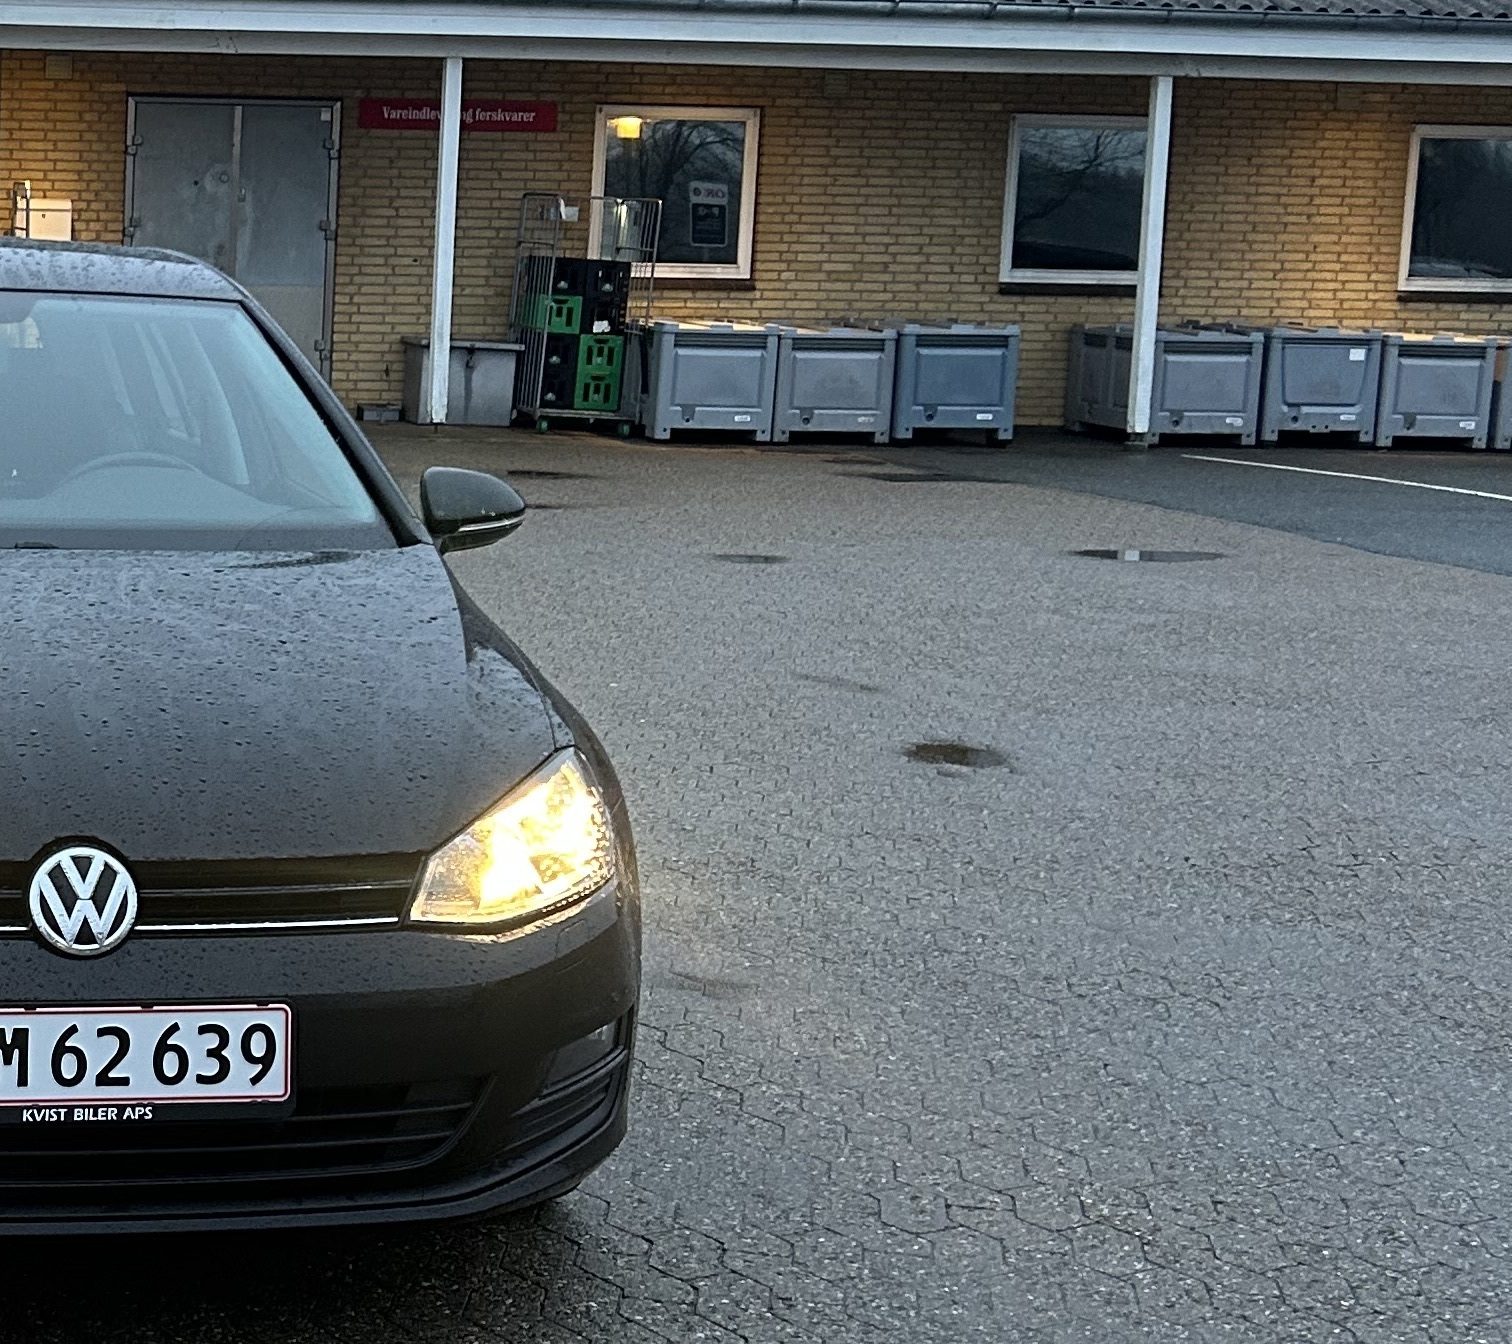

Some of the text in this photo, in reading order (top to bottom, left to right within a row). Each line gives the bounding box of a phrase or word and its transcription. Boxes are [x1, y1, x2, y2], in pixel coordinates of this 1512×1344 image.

[382, 106, 536, 124] Vareindlevng ferskvarer
[50, 1023, 131, 1088] 62
[152, 1020, 277, 1087] 639
[22, 1106, 153, 1122] KVIST BILER APS
